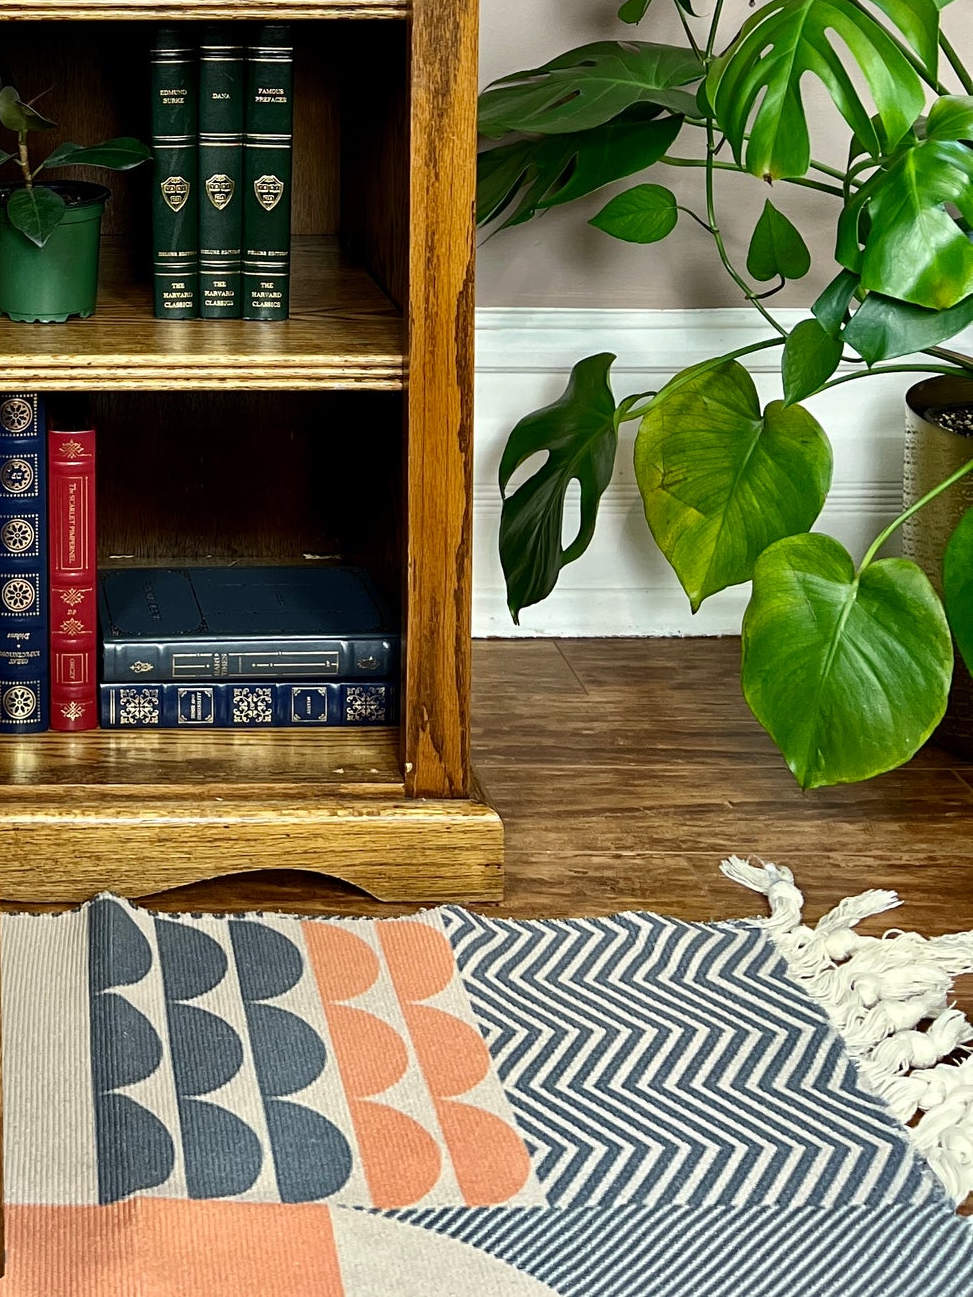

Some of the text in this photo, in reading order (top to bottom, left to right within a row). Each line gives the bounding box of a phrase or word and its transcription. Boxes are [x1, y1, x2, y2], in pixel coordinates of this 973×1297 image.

[68, 494, 77, 525] SCARLET
[68, 525, 77, 564] PIMPERNEL
[6, 632, 31, 641] Dickens
[68, 658, 76, 680] ORCZY
[213, 652, 221, 676] HARD
[220, 653, 228, 677] TIMES
